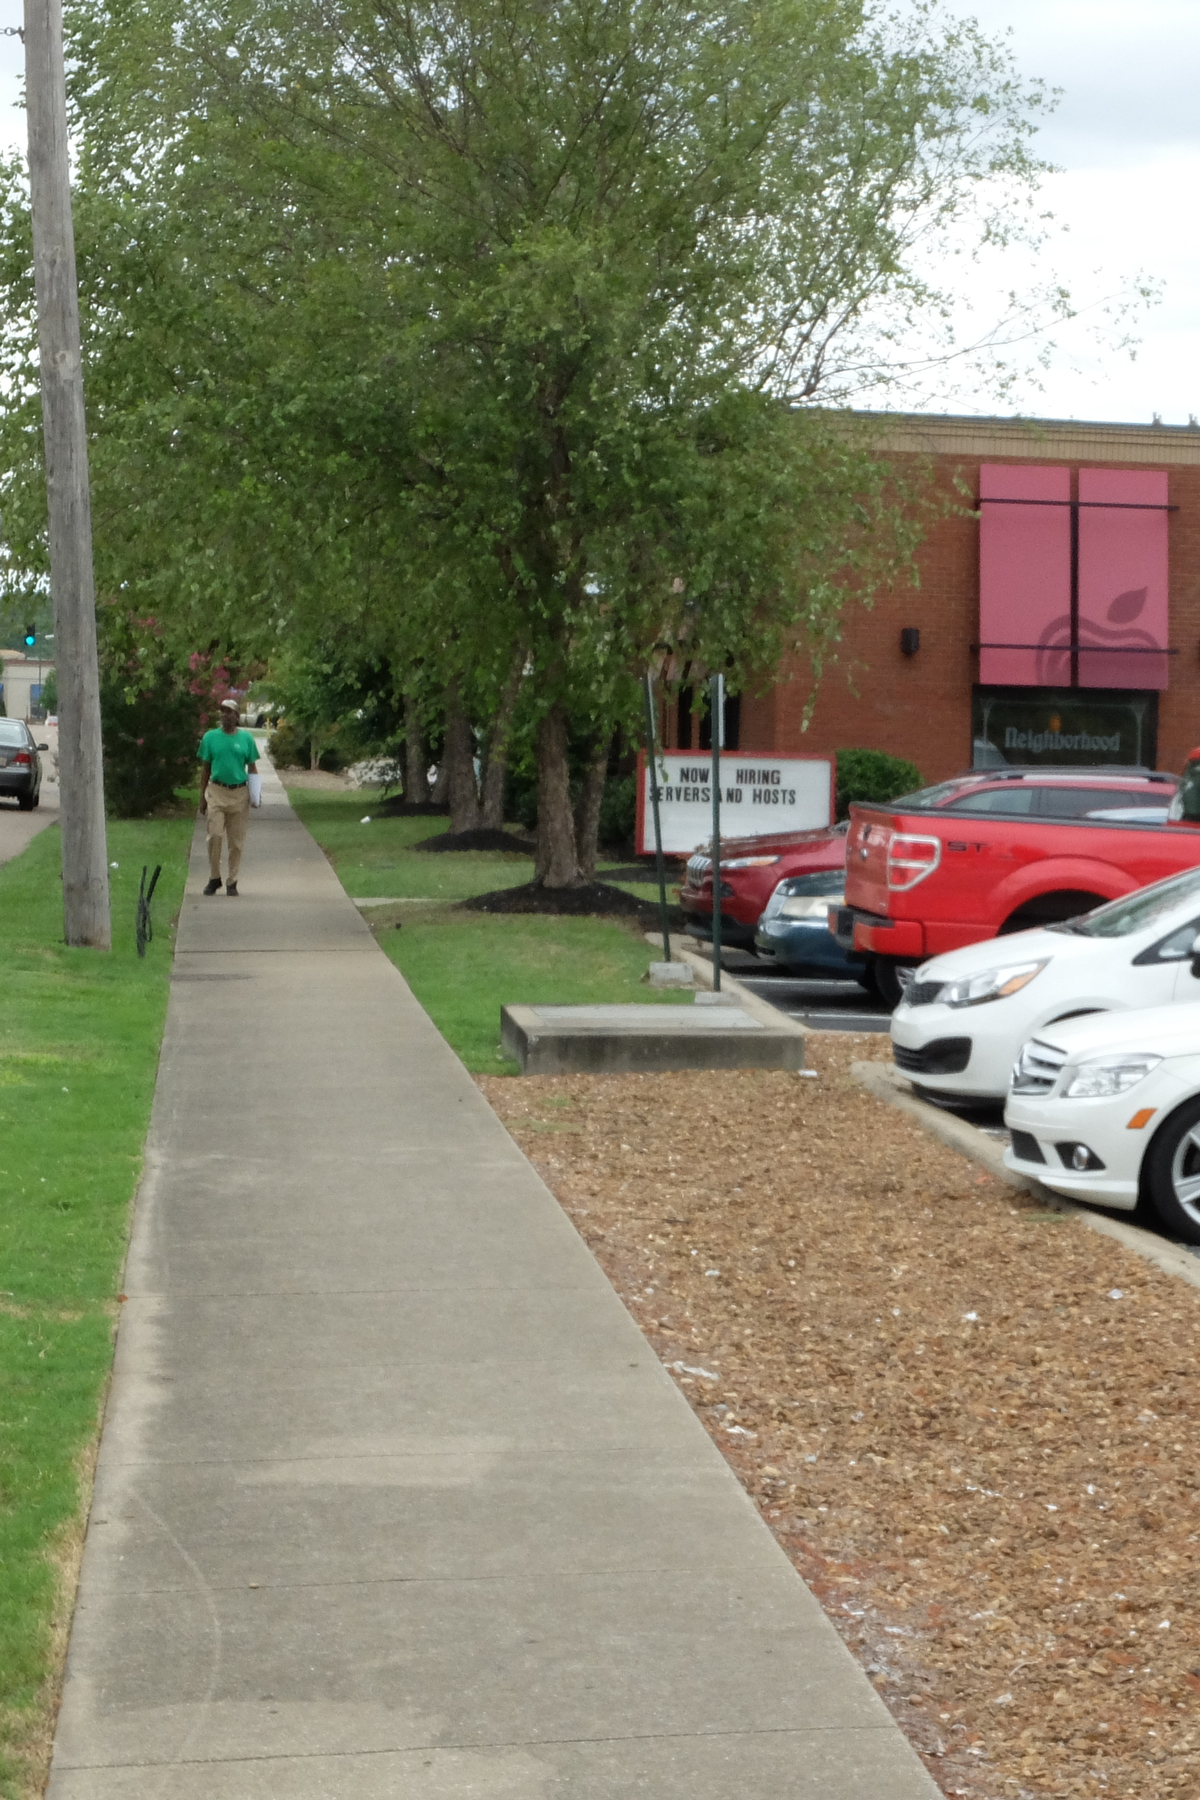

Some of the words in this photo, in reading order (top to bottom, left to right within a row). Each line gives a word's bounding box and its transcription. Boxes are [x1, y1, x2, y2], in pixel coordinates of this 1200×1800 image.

[1005, 727, 1121, 753] Neighborhood
[680, 768, 709, 783] NOW
[736, 769, 781, 785] HIRING
[753, 789, 796, 805] HOSTS
